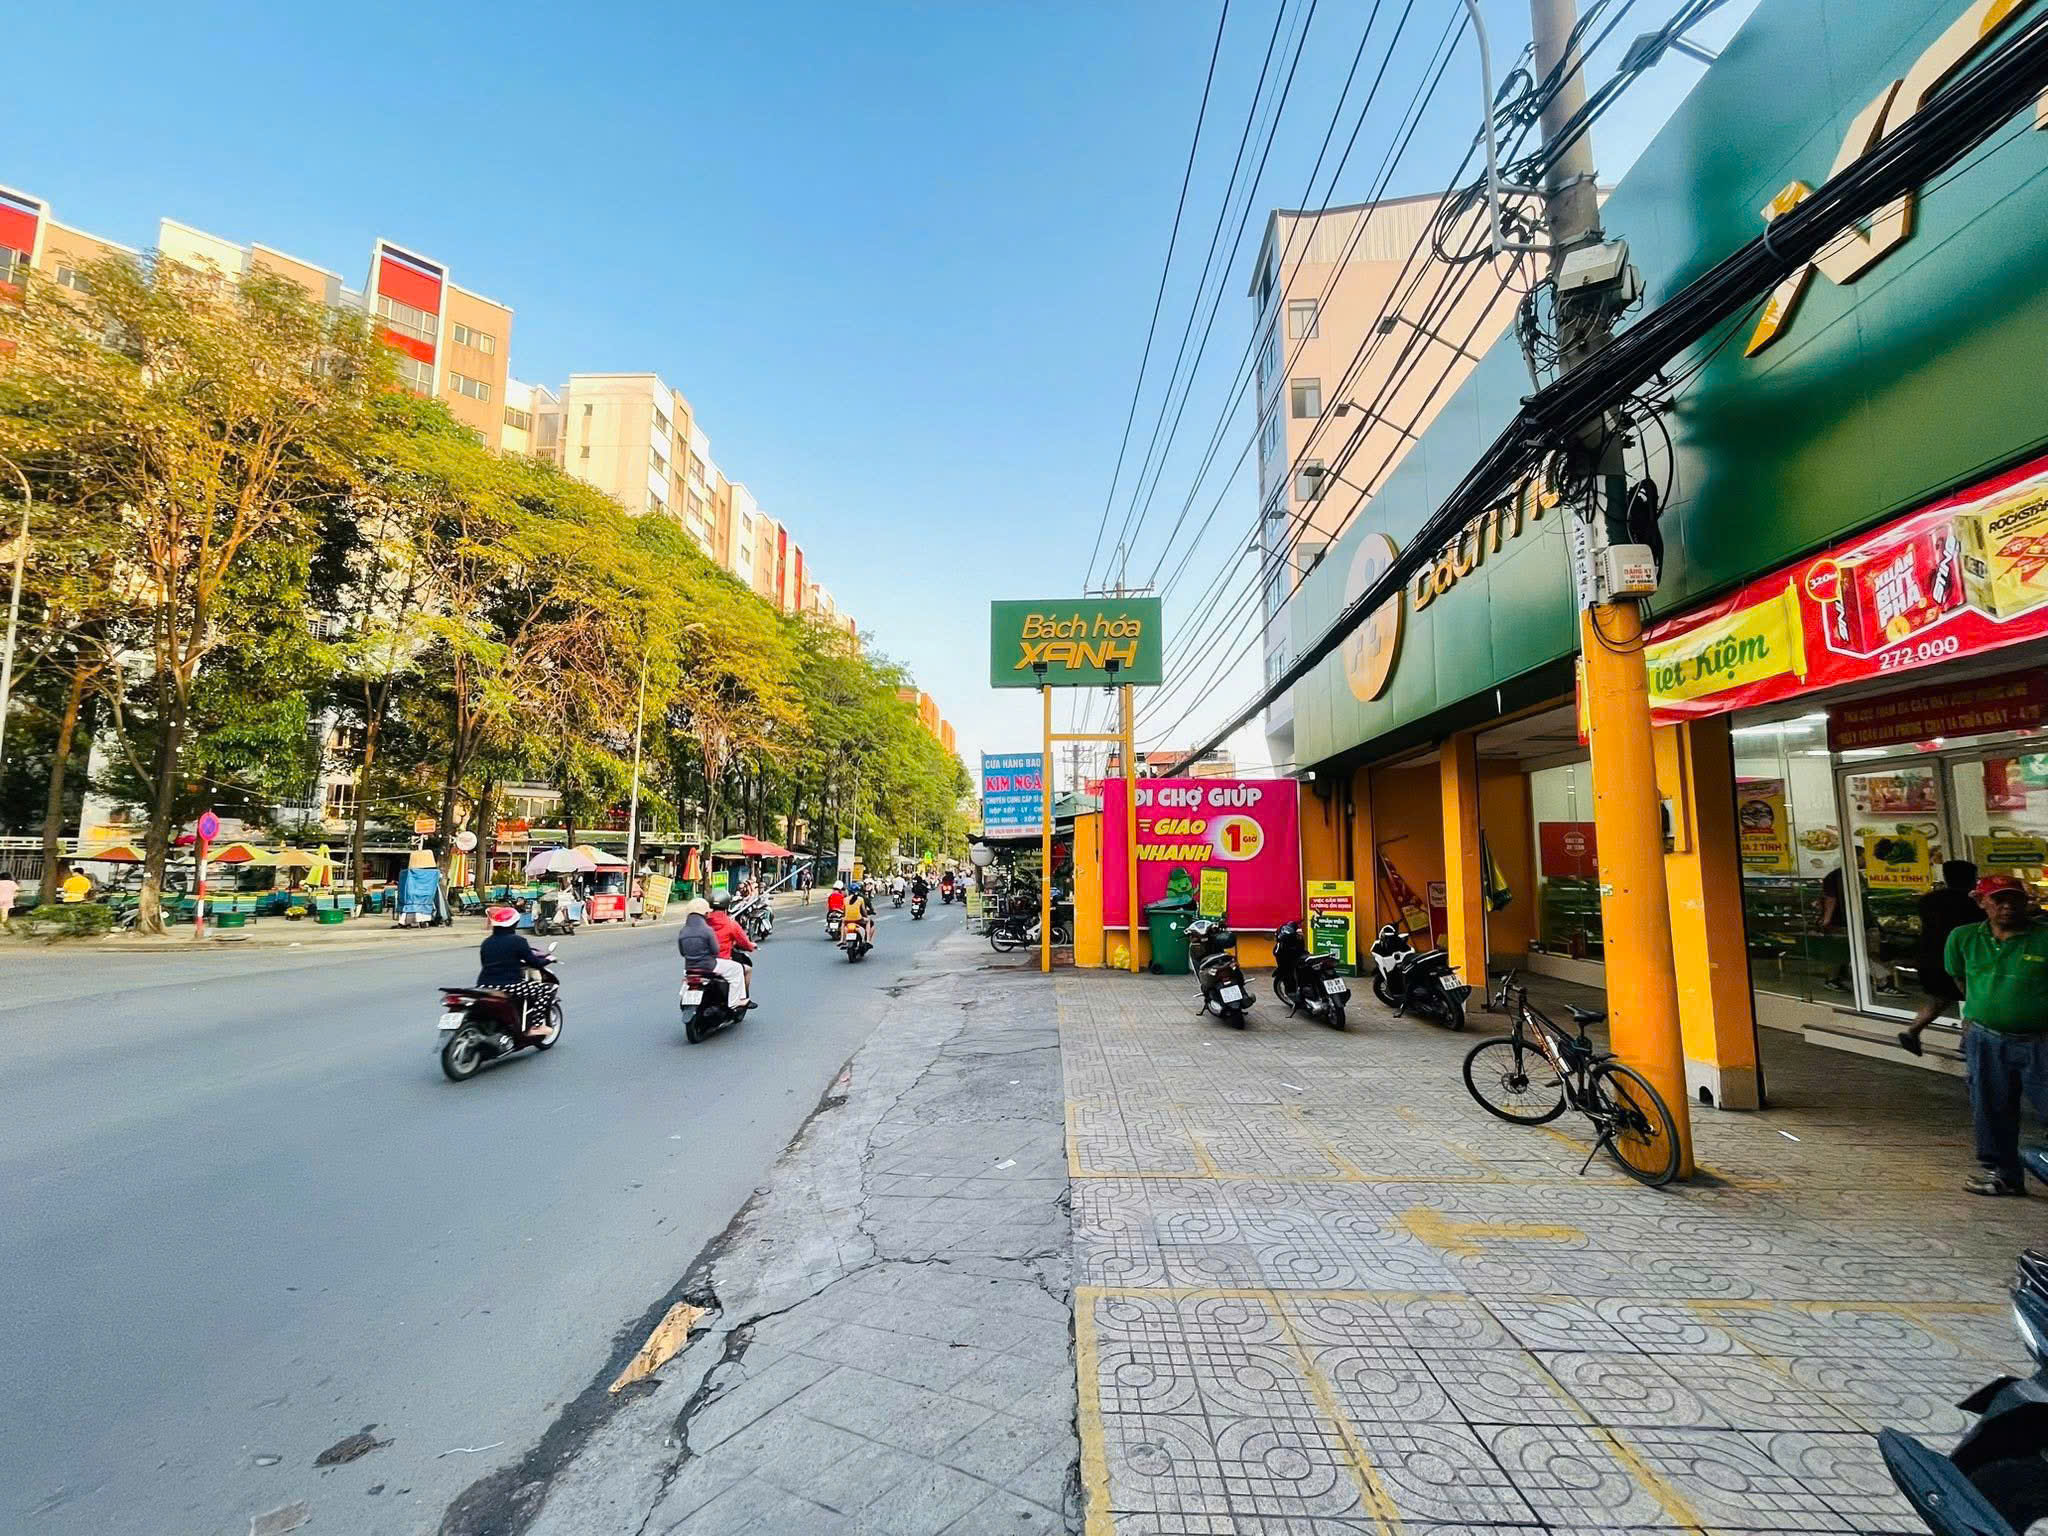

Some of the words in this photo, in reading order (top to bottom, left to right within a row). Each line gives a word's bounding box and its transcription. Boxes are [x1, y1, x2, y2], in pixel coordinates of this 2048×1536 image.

[1022, 613, 1087, 639] Bách
[1092, 613, 1141, 639] hóa
[1014, 640, 1138, 670] XANH
[1690, 635, 1770, 680] Kiệm
[1879, 636, 1959, 671] 272.000
[985, 775, 1011, 792] KIM
[1013, 769, 1043, 792] NGÂ
[1157, 786, 1203, 812] CHỢ
[1207, 782, 1262, 807] GIÚP
[1154, 818, 1208, 835] GIAO
[1225, 824, 1241, 852] 1
[1136, 844, 1213, 861] NHANH
